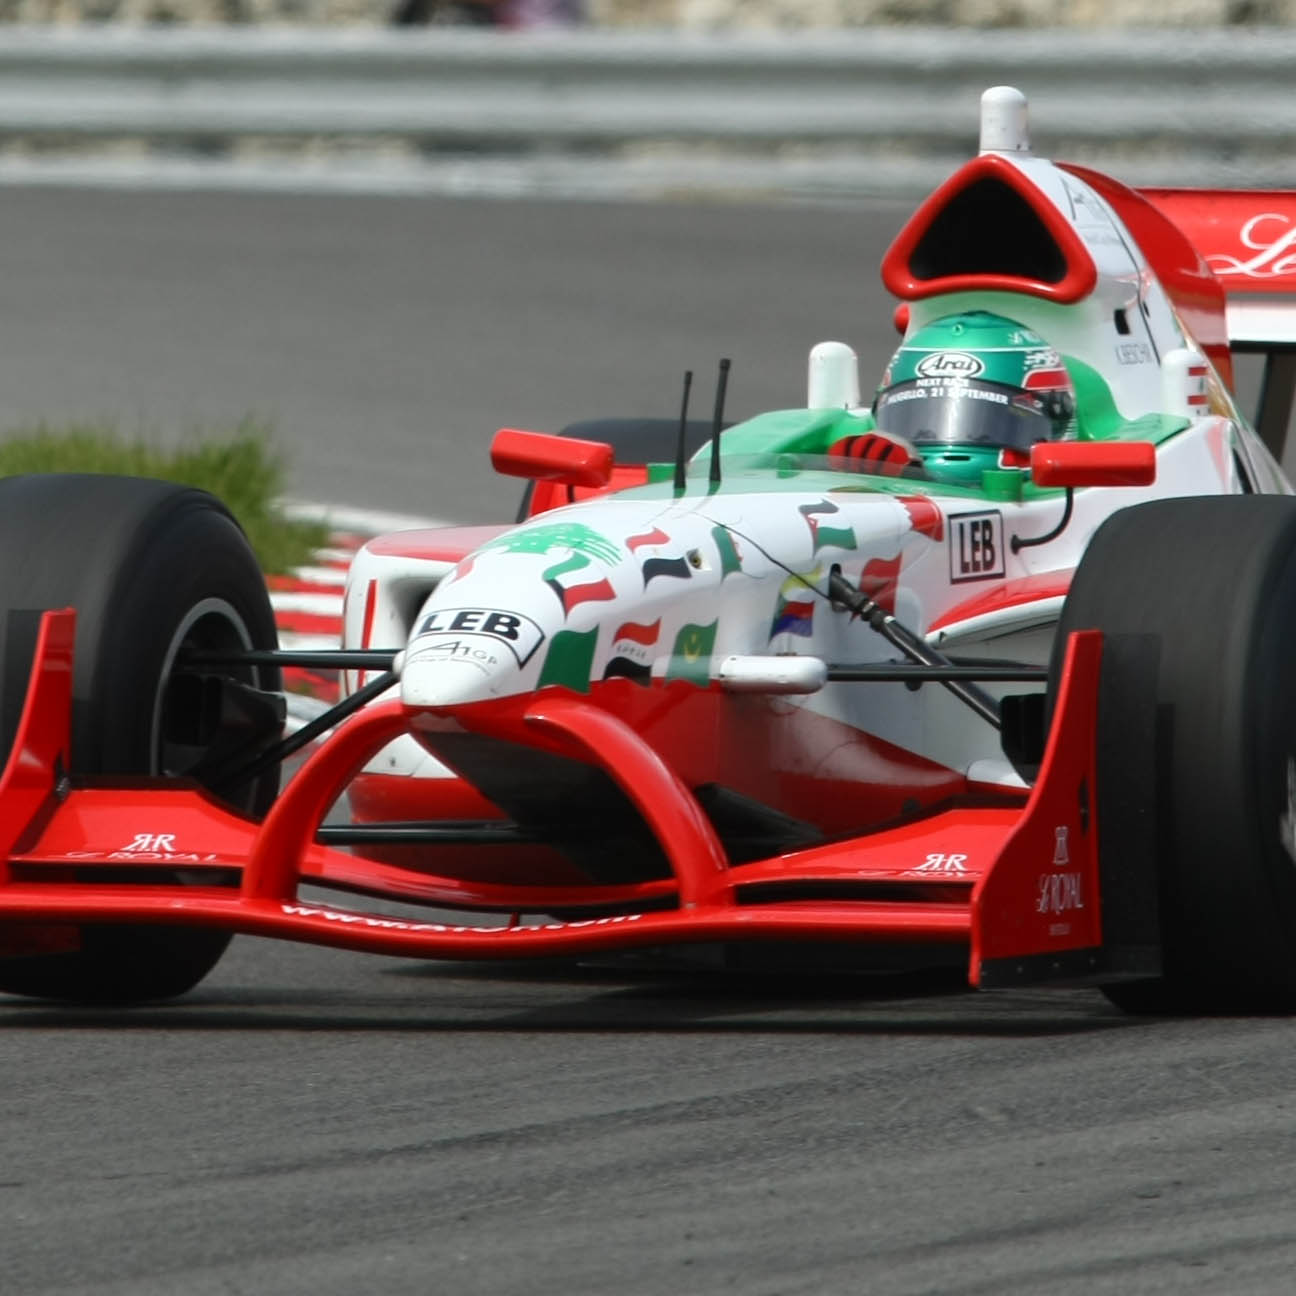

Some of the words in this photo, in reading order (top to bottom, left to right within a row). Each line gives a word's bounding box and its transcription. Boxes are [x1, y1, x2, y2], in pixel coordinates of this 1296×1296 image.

[923, 356, 974, 371] Arai
[916, 378, 942, 387] NEXT
[931, 387, 944, 397] 21
[947, 387, 1009, 405] SEPTEMBER
[959, 519, 995, 573] LEB
[418, 611, 521, 641] LEB
